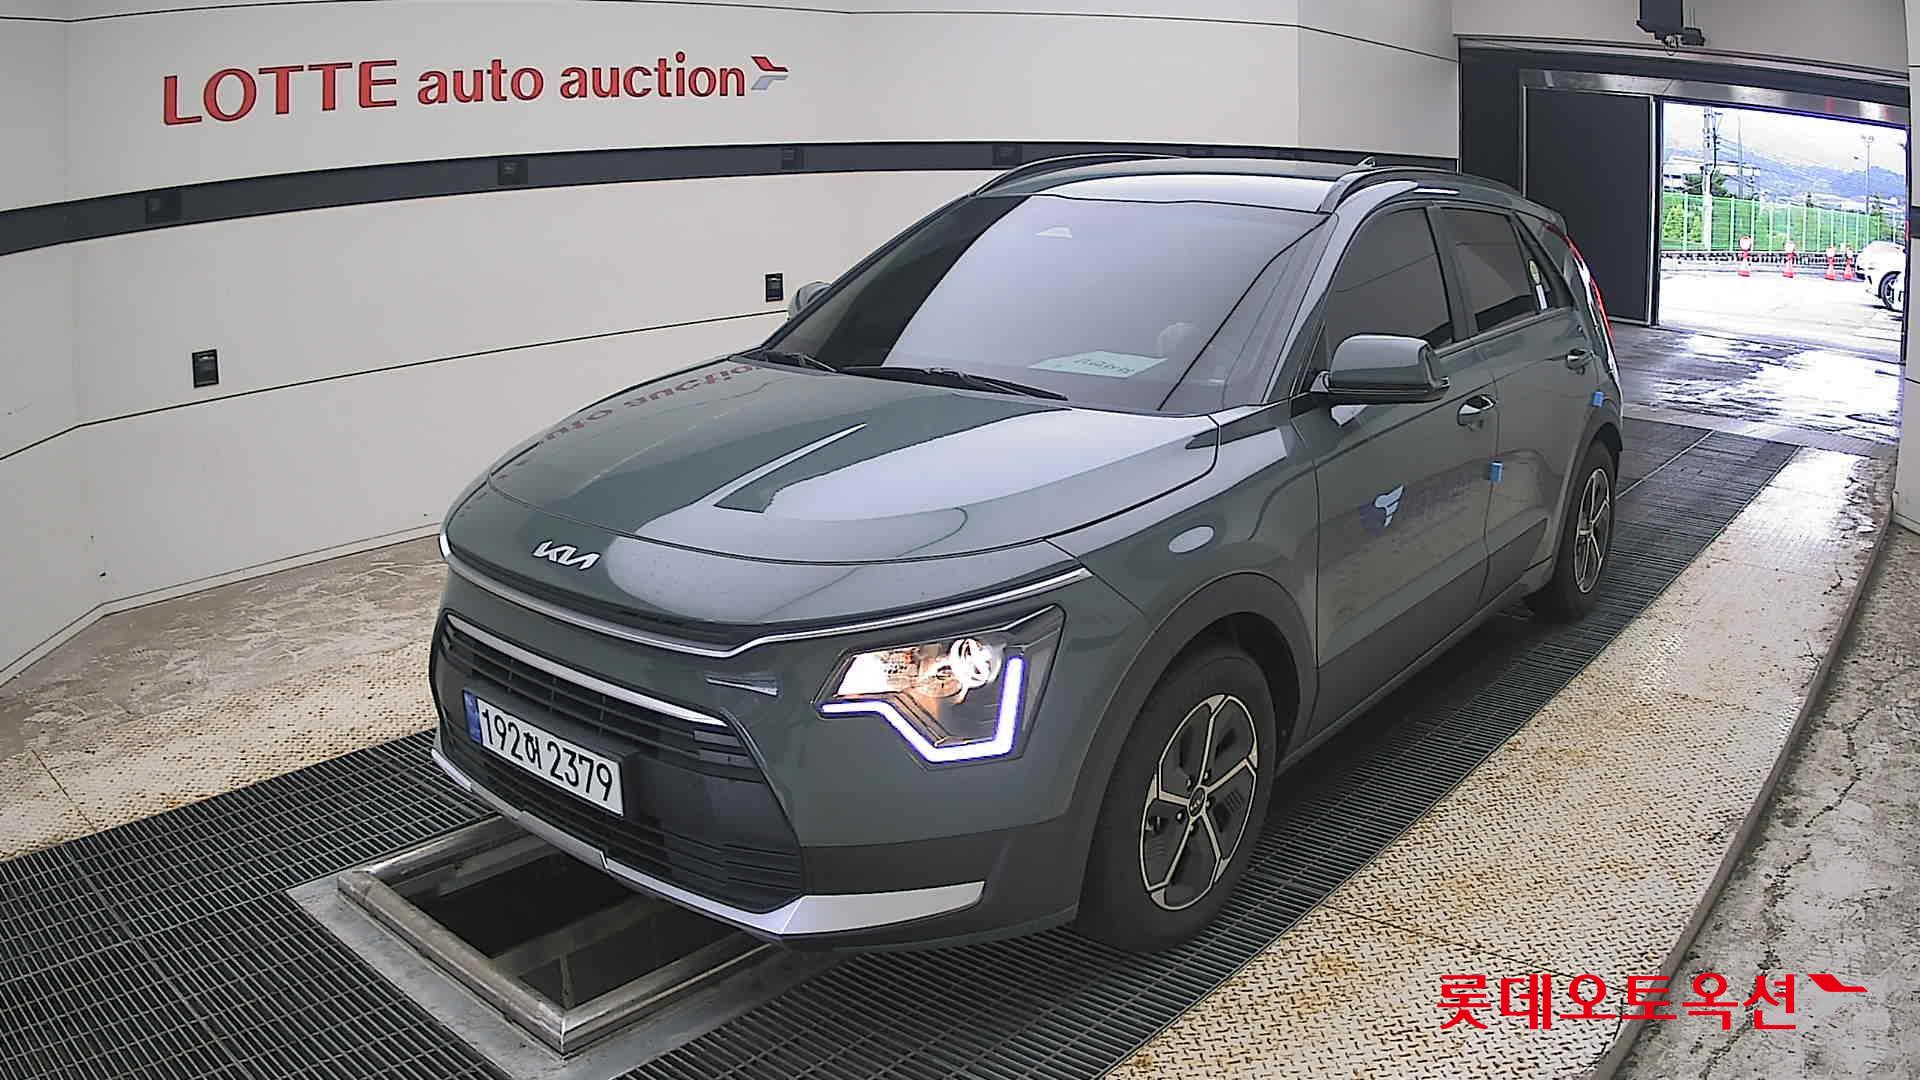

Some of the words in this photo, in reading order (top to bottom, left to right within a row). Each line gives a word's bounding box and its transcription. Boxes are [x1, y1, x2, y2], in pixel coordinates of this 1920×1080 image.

[162, 59, 398, 126] LOTTE
[417, 58, 545, 106] auto
[560, 51, 746, 100] auction
[532, 540, 600, 570] KIA
[547, 741, 614, 801] 2379
